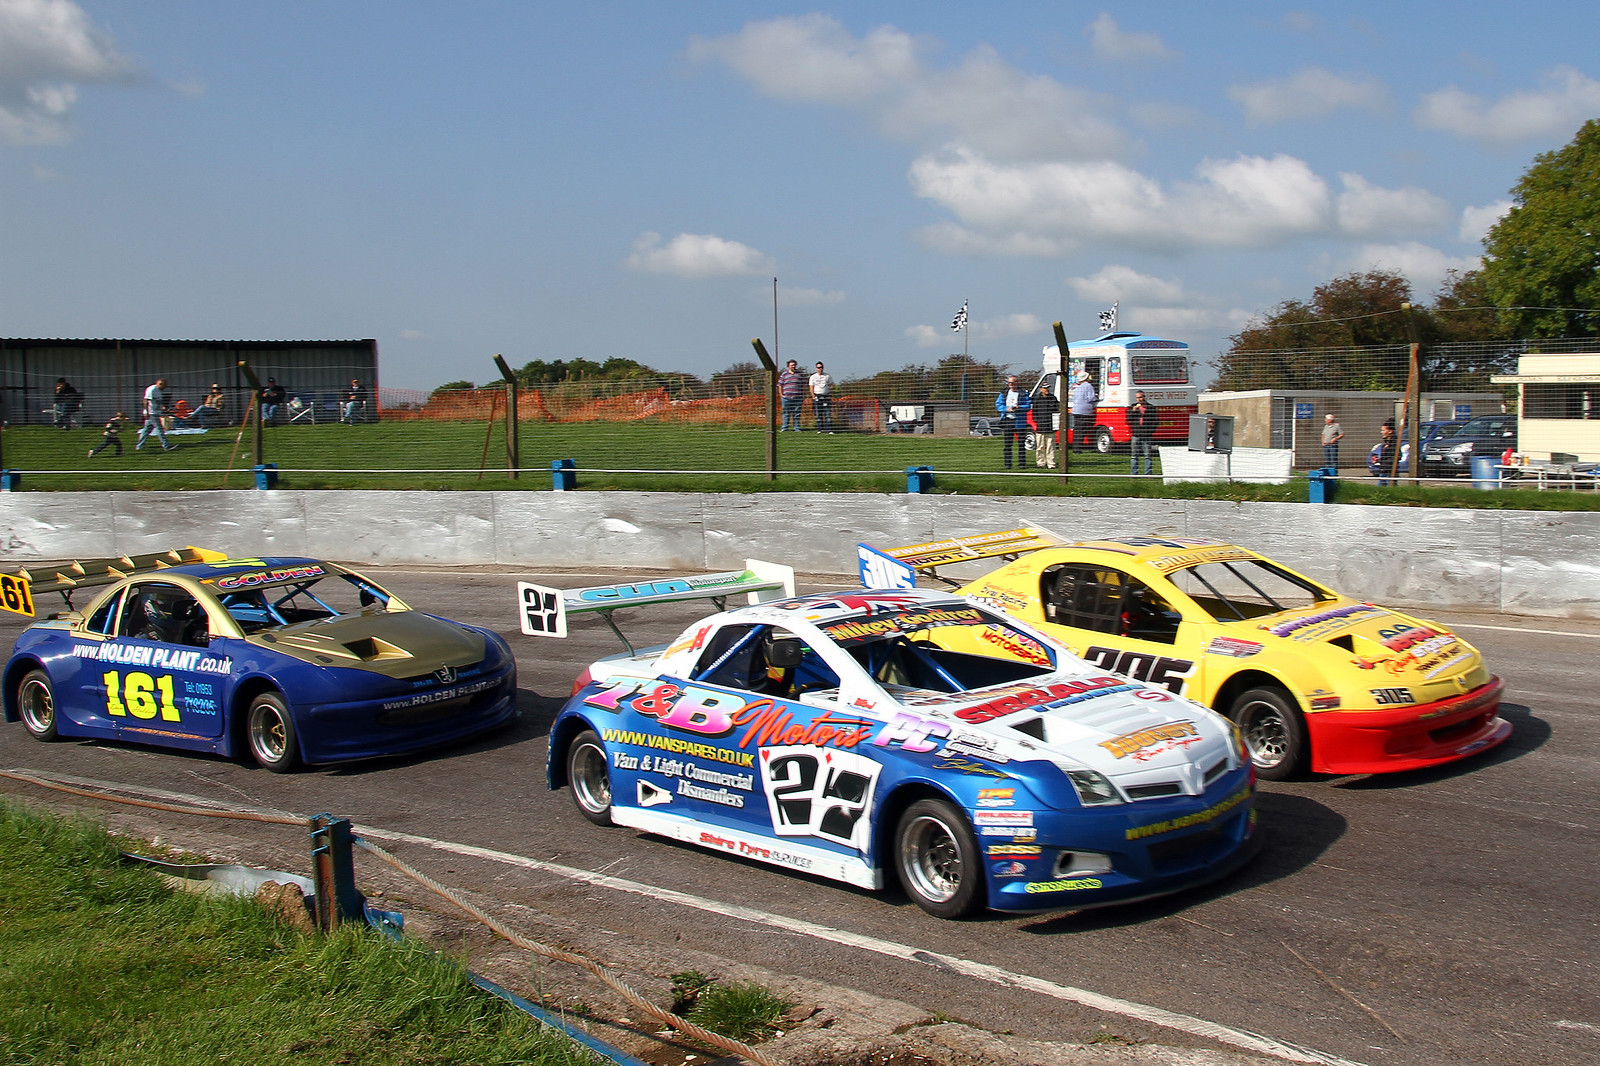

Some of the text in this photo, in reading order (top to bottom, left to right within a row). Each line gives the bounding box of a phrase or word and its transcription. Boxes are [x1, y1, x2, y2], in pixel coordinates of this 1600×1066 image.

[218, 566, 325, 588] GOLDEN
[858, 546, 914, 589] 305
[0, 576, 32, 614] 61
[523, 588, 558, 633] 27
[827, 619, 898, 640] Mikey
[72, 642, 233, 675] www.HOLDEN PLANT.co.uk
[103, 670, 181, 722] 161
[184, 681, 196, 694] Tel:
[953, 676, 1127, 724] SIBBALD
[1370, 687, 1416, 705] 305
[583, 675, 874, 749] T&B Motors
[602, 729, 755, 768] WWW.VANSPARES.CO.UK
[873, 712, 951, 753] PC
[613, 752, 753, 791] Van & Light Commercial
[677, 779, 745, 808] Dismantlers
[770, 753, 873, 840] 27
[739, 841, 771, 858] Tyre
